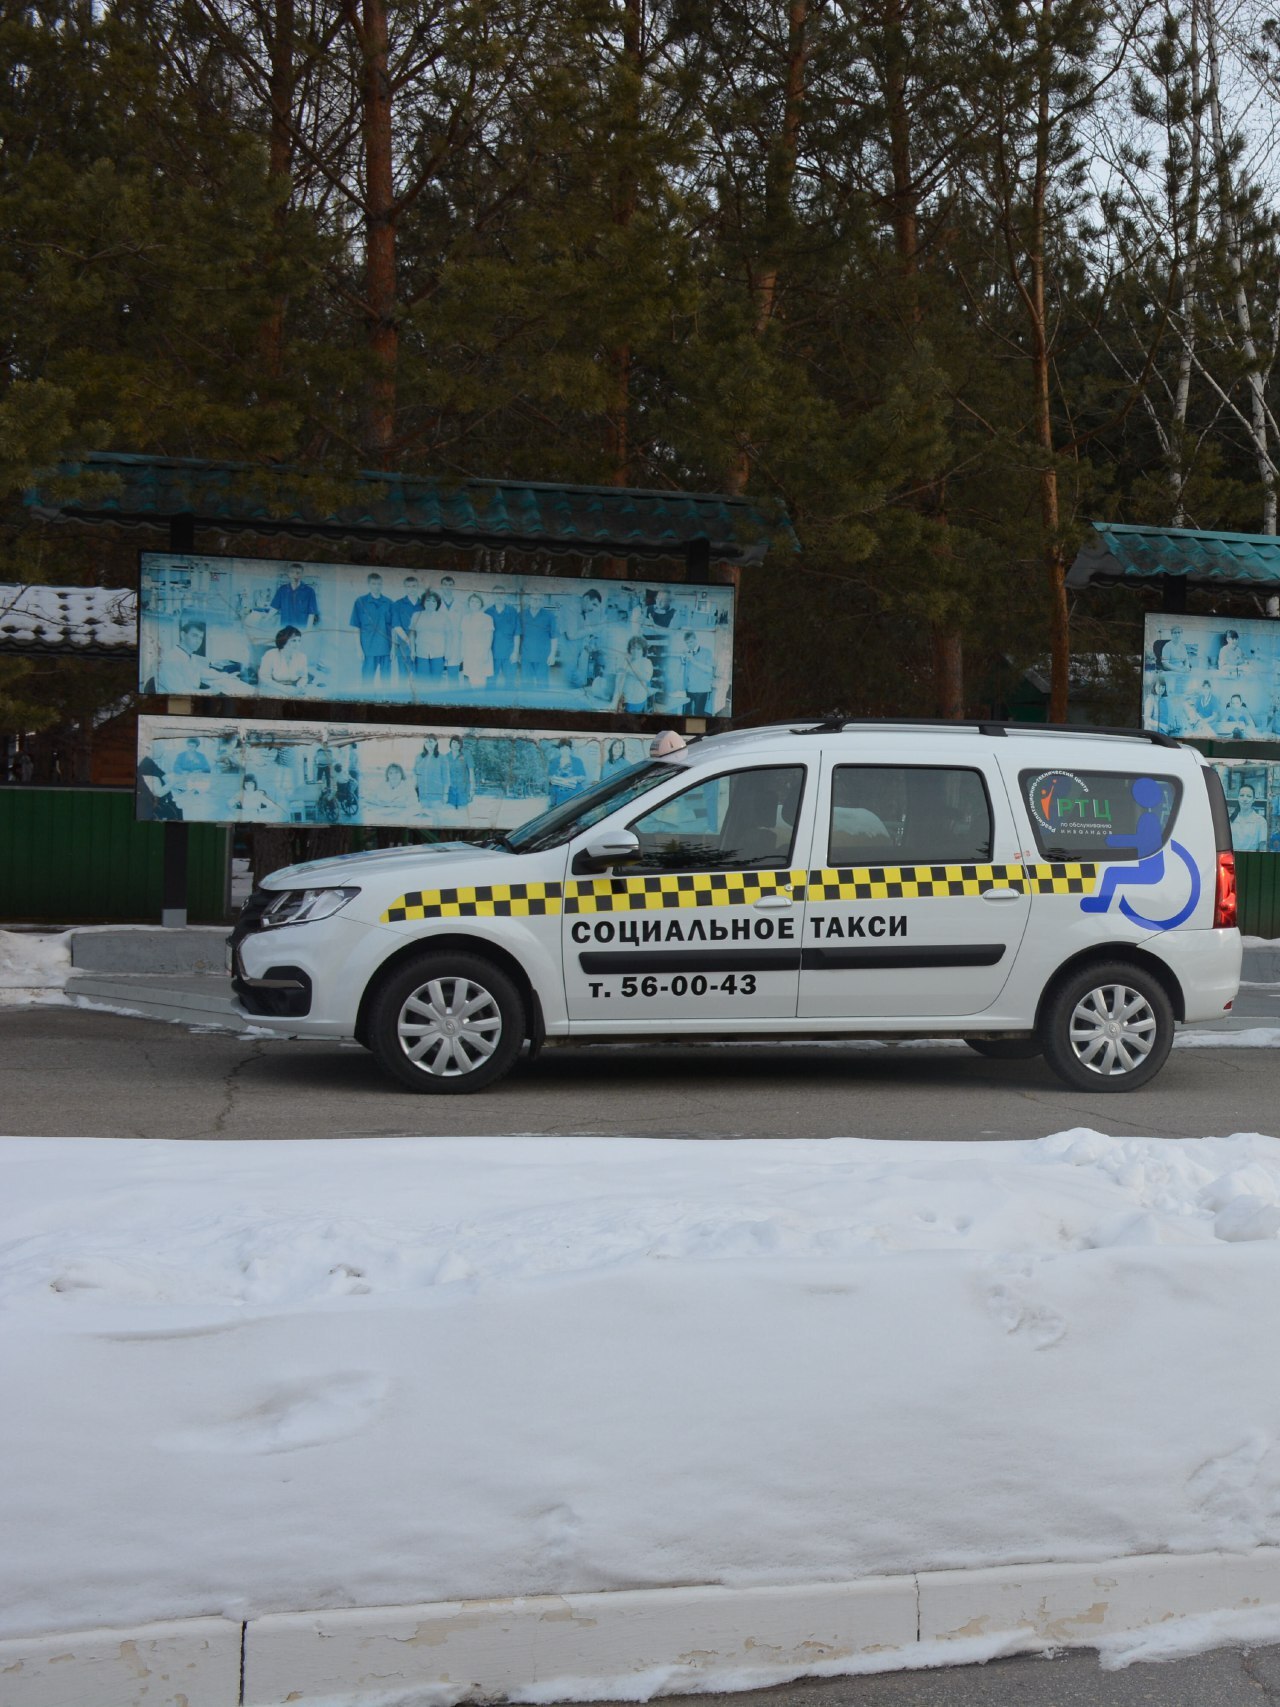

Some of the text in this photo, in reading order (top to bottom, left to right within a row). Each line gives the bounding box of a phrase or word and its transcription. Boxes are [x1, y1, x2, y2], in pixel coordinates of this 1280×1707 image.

[1074, 776, 1090, 793] центр
[1056, 797, 1112, 822] РТЦ
[571, 915, 908, 947] СОЦИАЛЬНОЕ ТАКСИ
[588, 974, 757, 998] т. 56-00-43
